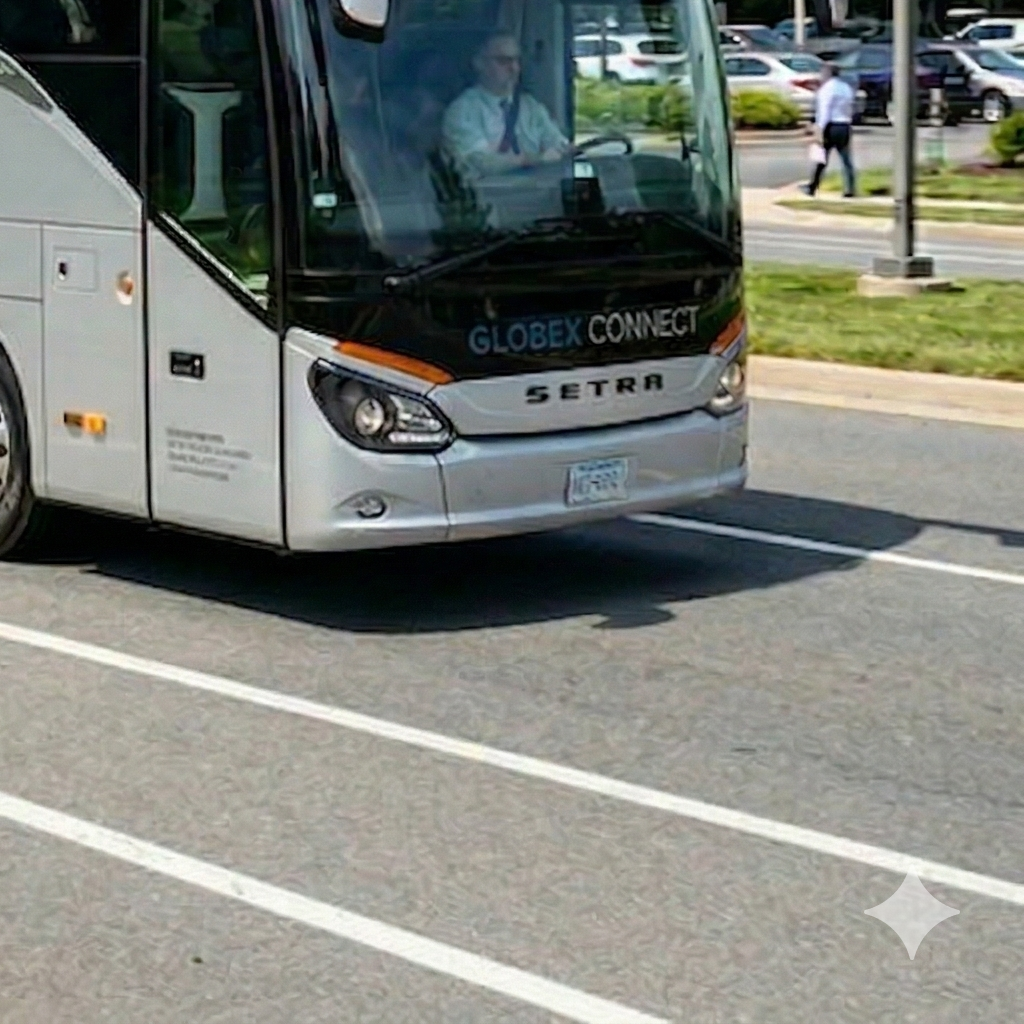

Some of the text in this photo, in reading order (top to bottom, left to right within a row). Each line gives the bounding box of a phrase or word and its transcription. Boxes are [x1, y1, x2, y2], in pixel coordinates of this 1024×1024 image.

[468, 305, 701, 355] GLOBEX CONNECT
[525, 373, 665, 404] SETRA
